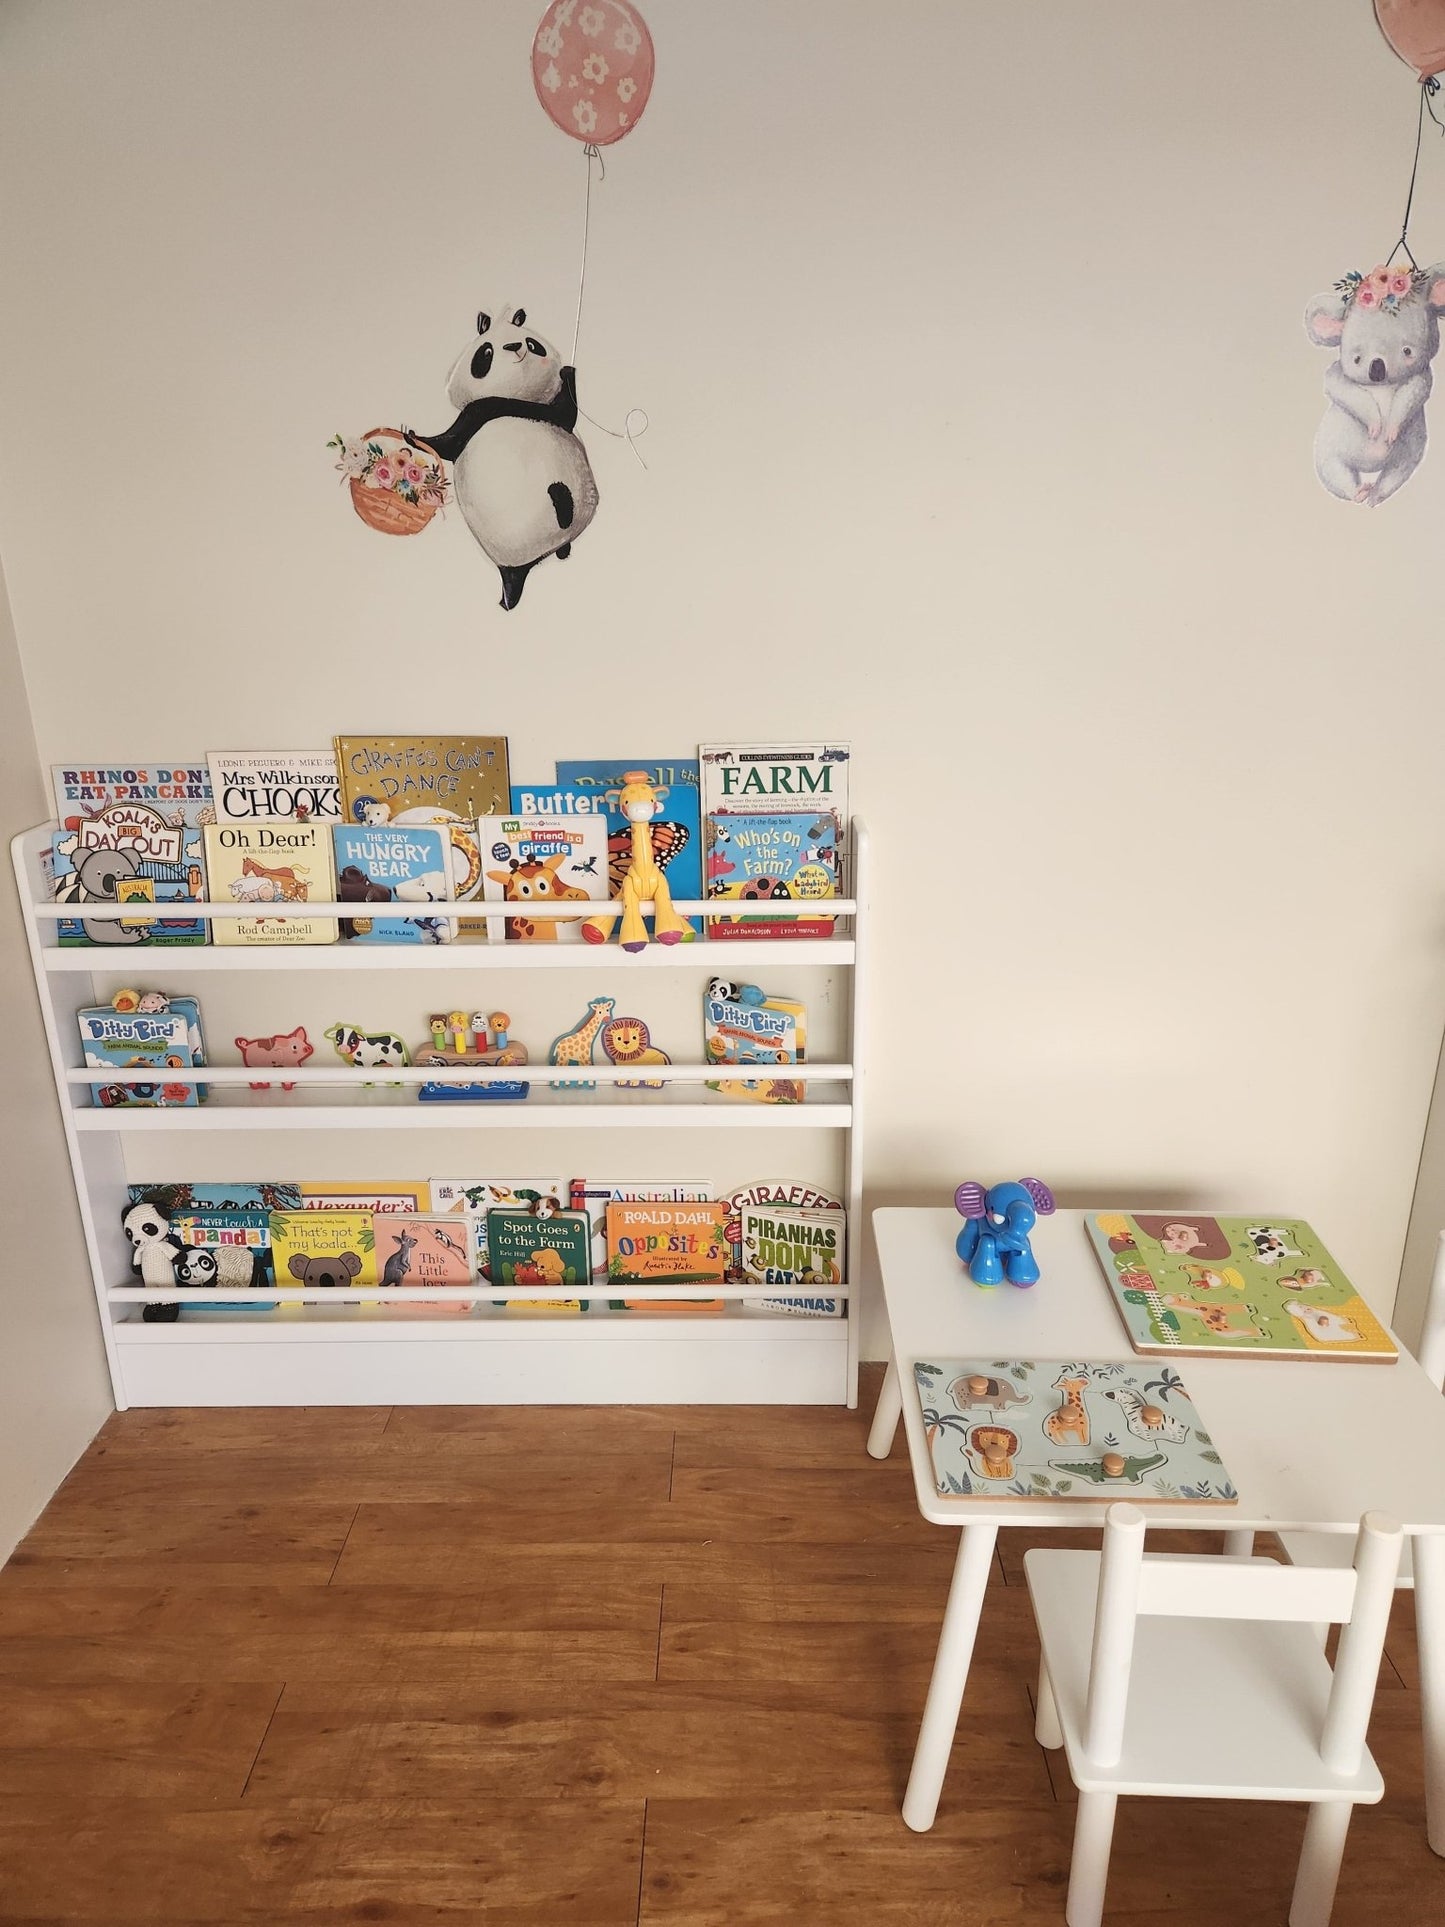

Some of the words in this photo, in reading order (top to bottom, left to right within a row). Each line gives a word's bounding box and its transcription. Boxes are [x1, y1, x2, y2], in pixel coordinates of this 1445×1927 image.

[351, 747, 438, 775] GIRAFFES
[445, 745, 495, 772] CAN'T
[62, 769, 148, 785] RHINOS
[221, 771, 255, 786] Mrs
[720, 765, 833, 794] FARM
[65, 786, 106, 800] EAT
[380, 774, 460, 799] DANCE
[102, 810, 162, 834] KOALA'S
[504, 823, 518, 832] My
[122, 827, 137, 835] BIG
[219, 829, 251, 848] Oh
[257, 828, 316, 847] Dear!
[364, 833, 383, 842] THE
[385, 834, 409, 843] VERY
[511, 830, 531, 841] best
[534, 831, 564, 841] friend
[567, 834, 573, 842] is
[734, 828, 780, 849] Who's
[86, 831, 123, 850] DAY
[131, 838, 175, 857] OUT
[521, 842, 570, 856] giraffe
[346, 841, 431, 863] HUNGRY
[756, 846, 778, 859] the
[369, 861, 412, 878] BEAR
[743, 858, 793, 876] Farm?
[237, 925, 258, 935] Rod
[261, 924, 313, 936] Campbell
[711, 1002, 749, 1026] Ditty
[749, 1011, 788, 1034] Bird
[87, 1018, 133, 1040] Ditty
[133, 1018, 175, 1042] Bird
[611, 1188, 708, 1202] Australian
[202, 1218, 223, 1227] NEVER
[225, 1215, 257, 1228] touch
[258, 1218, 263, 1227] A
[623, 1211, 672, 1224] ROALD
[675, 1212, 715, 1225] DAHL
[290, 1225, 328, 1237] That's
[331, 1226, 353, 1237] not
[503, 1220, 533, 1235] Spot
[536, 1222, 569, 1235] Goes
[747, 1216, 837, 1248] PIRANHAS
[193, 1229, 267, 1247] panda!
[289, 1240, 309, 1252] my
[313, 1238, 357, 1249] koala...
[498, 1235, 512, 1245] to
[514, 1235, 536, 1247] the
[539, 1236, 575, 1249] Farm
[618, 1234, 720, 1259] Opposites
[419, 1252, 445, 1265] This
[758, 1237, 836, 1278] DON'T
[418, 1265, 449, 1276] Little
[766, 1268, 793, 1285] EAT
